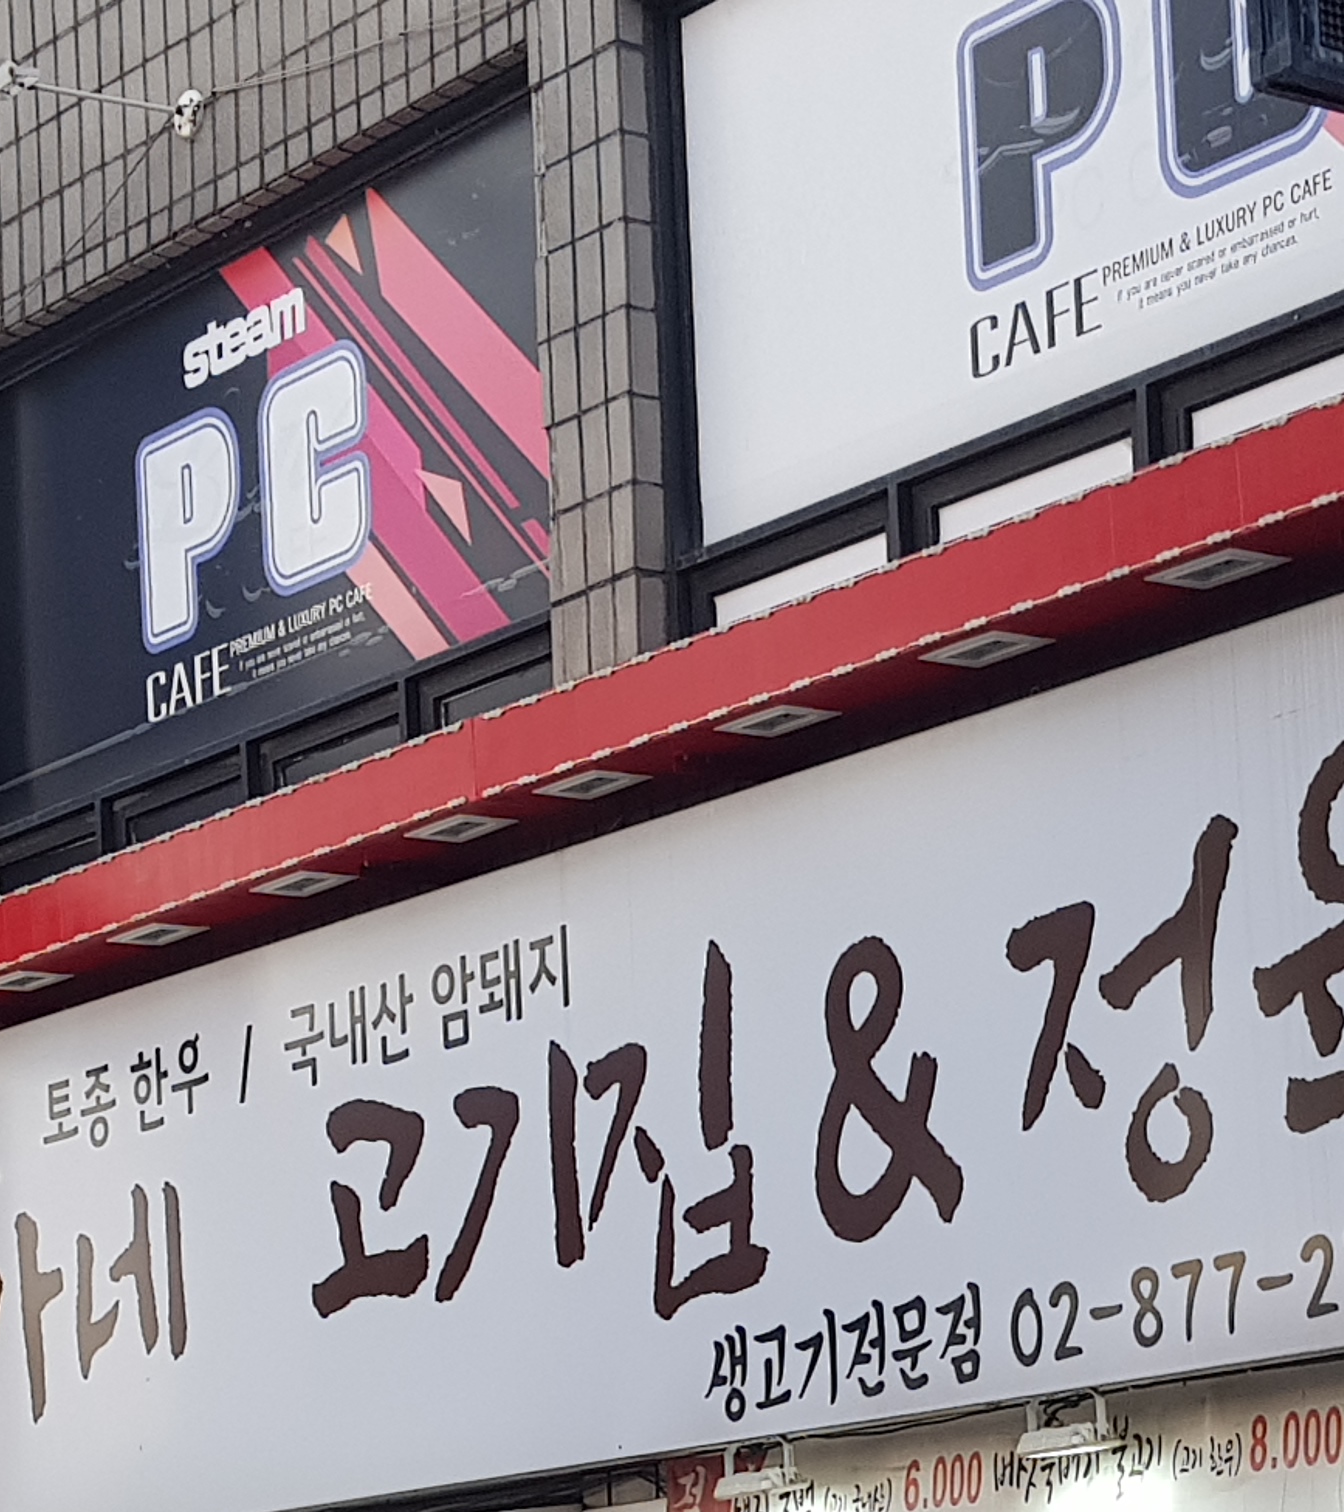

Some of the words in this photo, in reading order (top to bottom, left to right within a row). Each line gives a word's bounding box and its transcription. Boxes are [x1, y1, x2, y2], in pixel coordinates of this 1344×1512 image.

[1102, 238, 1175, 287] PREMIUM
[1179, 231, 1191, 253] &
[1196, 202, 1257, 246] LUXURY
[1262, 190, 1284, 218] PC
[1290, 168, 1333, 204] CAFE
[182, 287, 307, 389] steam
[968, 267, 1104, 380] CAFE
[135, 339, 372, 654] PC
[229, 622, 276, 658] PREMIUM
[288, 601, 328, 633] LUXURY
[329, 594, 344, 616] PC
[346, 582, 374, 609] CAFE
[145, 643, 232, 724] CAFE
[43, 1062, 117, 1150] 토종
[131, 1032, 211, 1135] 한우
[283, 973, 414, 1088] 국내산
[430, 925, 572, 1050] 암돼지
[311, 938, 771, 1321] 고기집
[815, 936, 963, 1242] &
[704, 1281, 984, 1425] 생고기전문점
[903, 1450, 984, 1512] 6.000
[1248, 1404, 1344, 1473] 8.000
